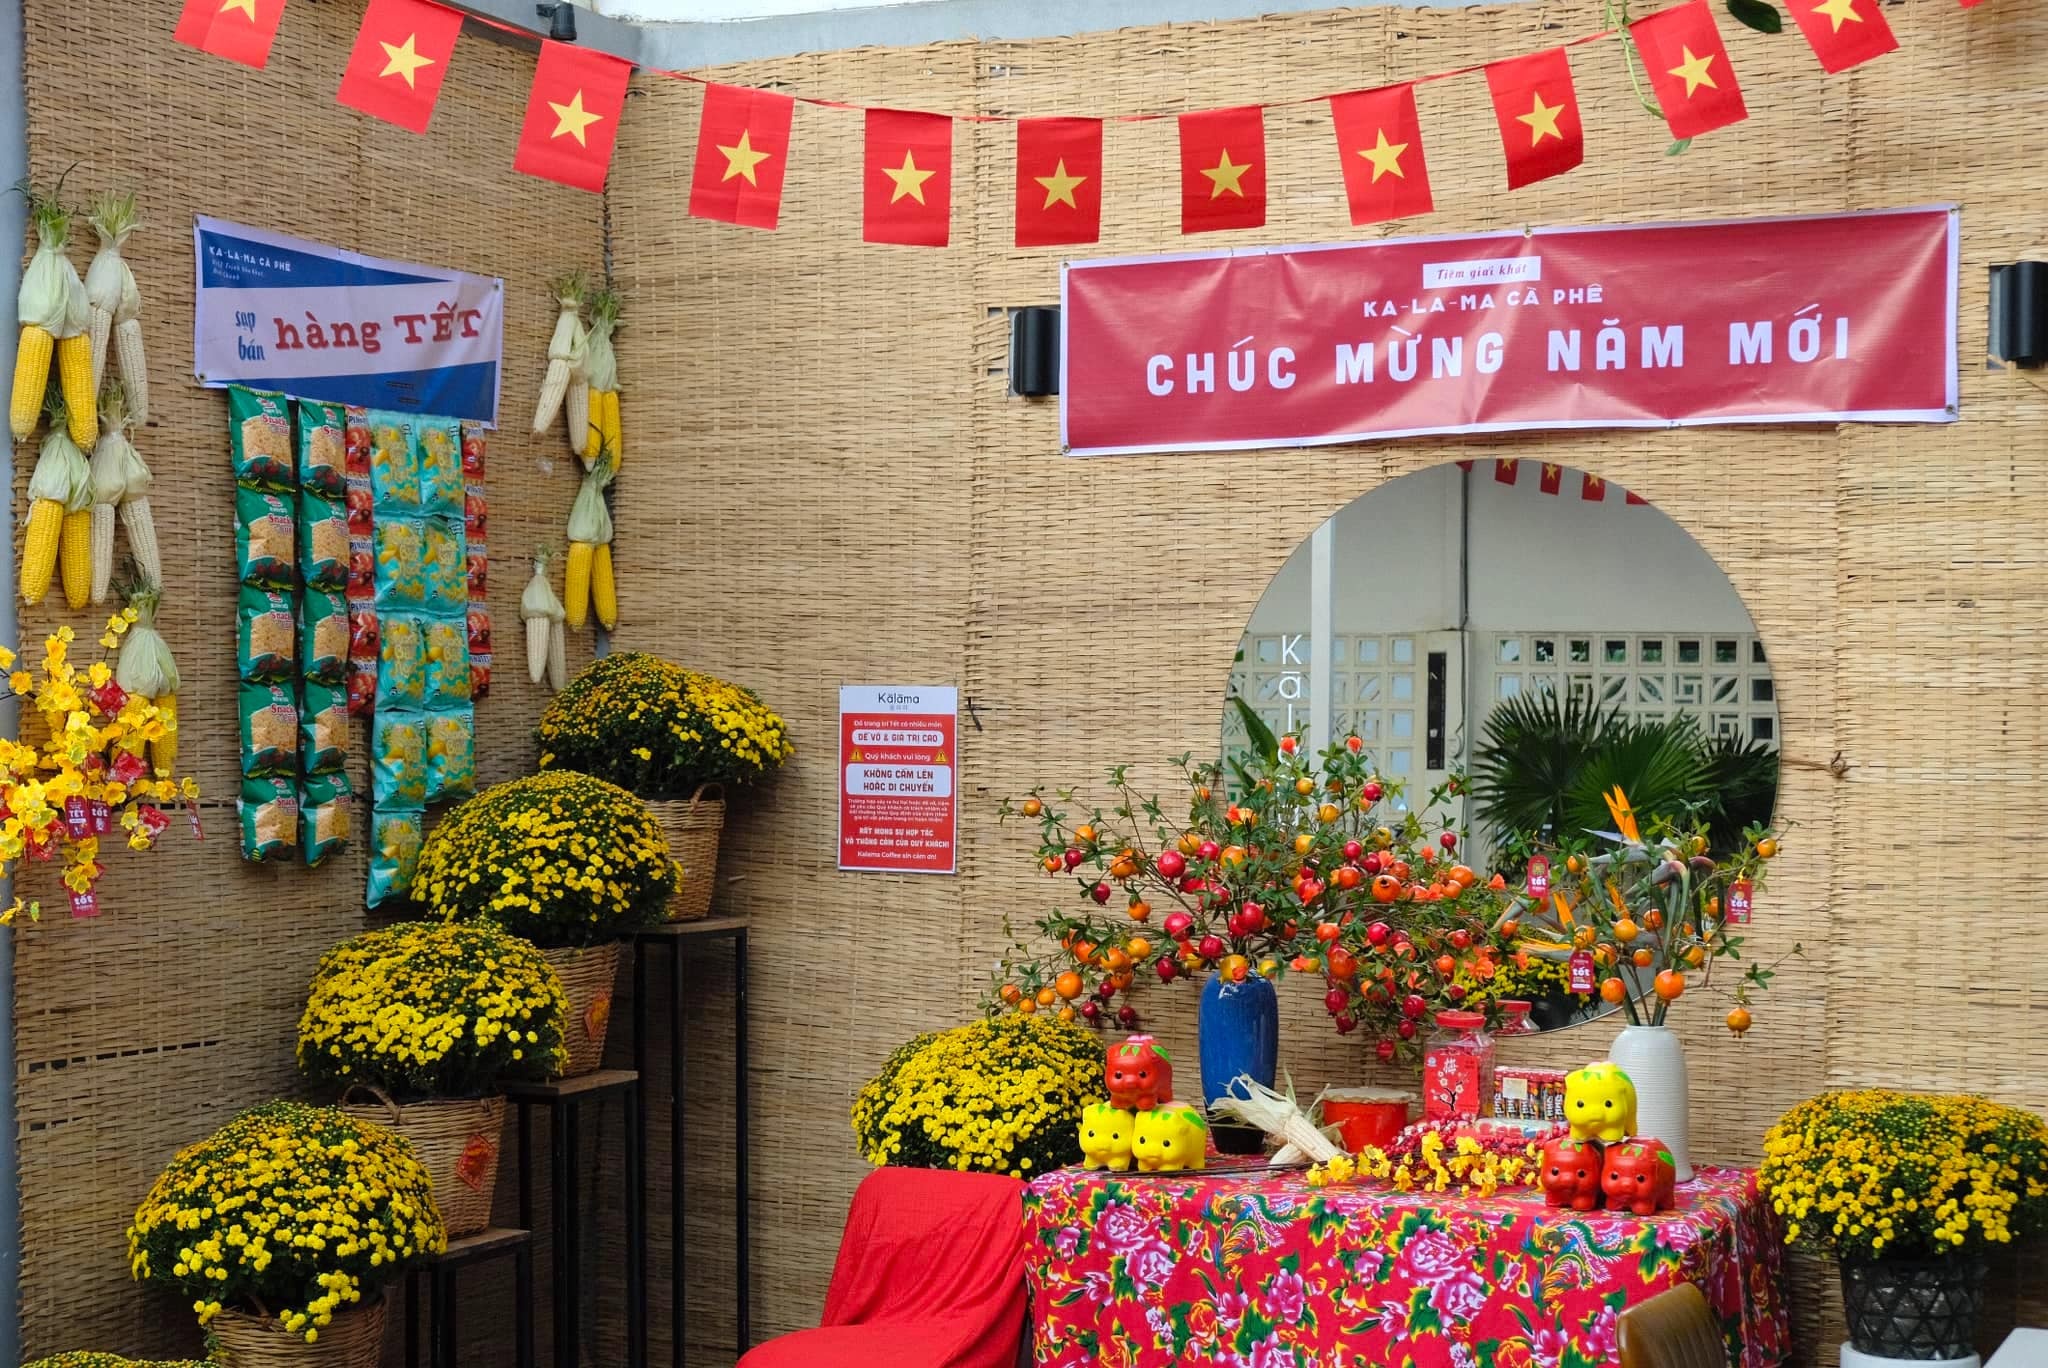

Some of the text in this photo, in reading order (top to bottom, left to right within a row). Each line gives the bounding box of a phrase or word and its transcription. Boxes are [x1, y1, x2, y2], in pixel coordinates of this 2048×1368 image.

[1364, 283, 1603, 318] KA-LA-MA CÀ PHÊ
[236, 310, 256, 332] sạp
[274, 300, 482, 354] hàng TẾT
[238, 336, 265, 361] bán
[1146, 304, 1849, 396] CHÚC MỪNG NĂM MỚI
[922, 734, 938, 742] CAO
[880, 752, 902, 760] khách
[864, 768, 892, 778] KHÔNG
